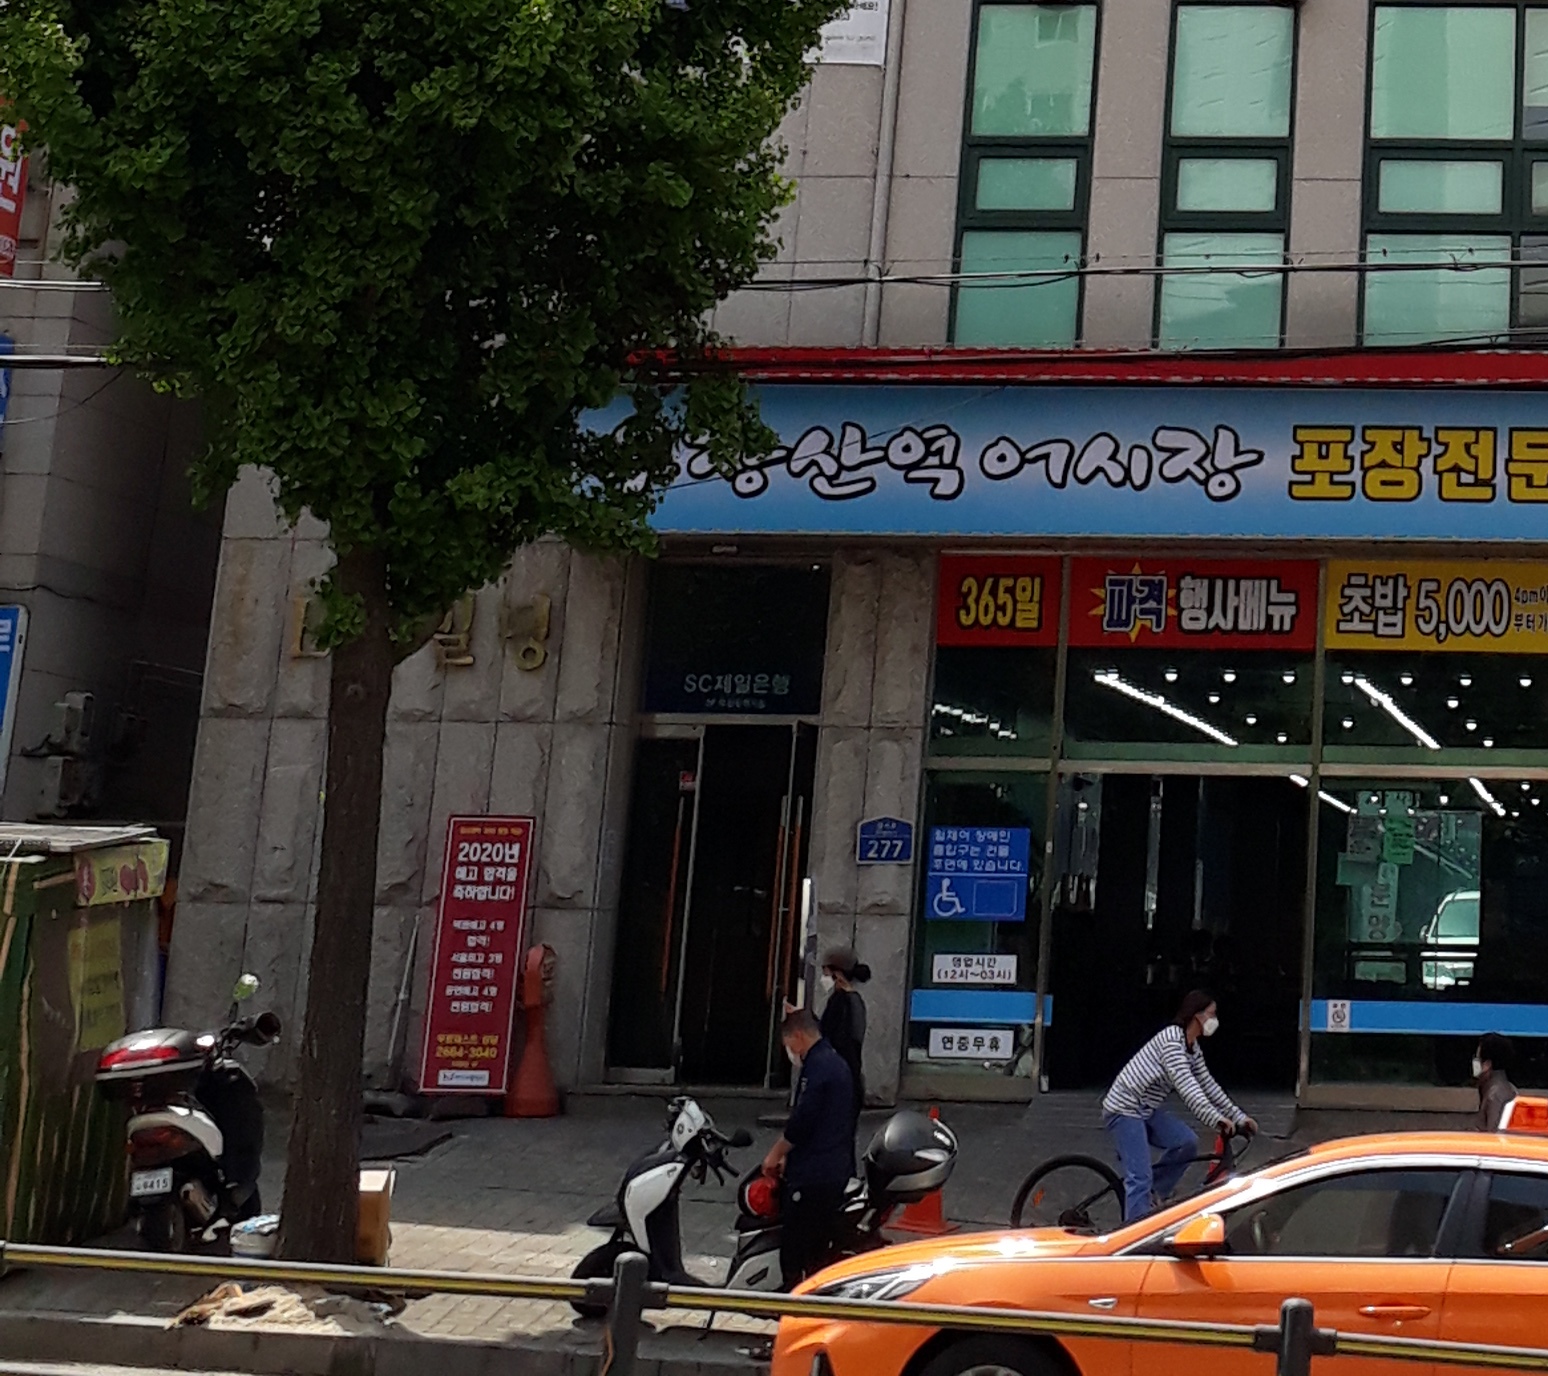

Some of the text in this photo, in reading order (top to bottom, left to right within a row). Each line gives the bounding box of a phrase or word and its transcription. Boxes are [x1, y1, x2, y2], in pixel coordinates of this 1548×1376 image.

[980, 425, 1264, 502] 어시장
[958, 574, 1042, 630] 365일
[1102, 574, 1298, 633] 파격 행사메뉴
[1336, 573, 1511, 642] 초밥 5,000
[683, 673, 792, 695] SC제일은행
[867, 839, 904, 859] 277
[941, 1035, 1003, 1053] 연중무휴
